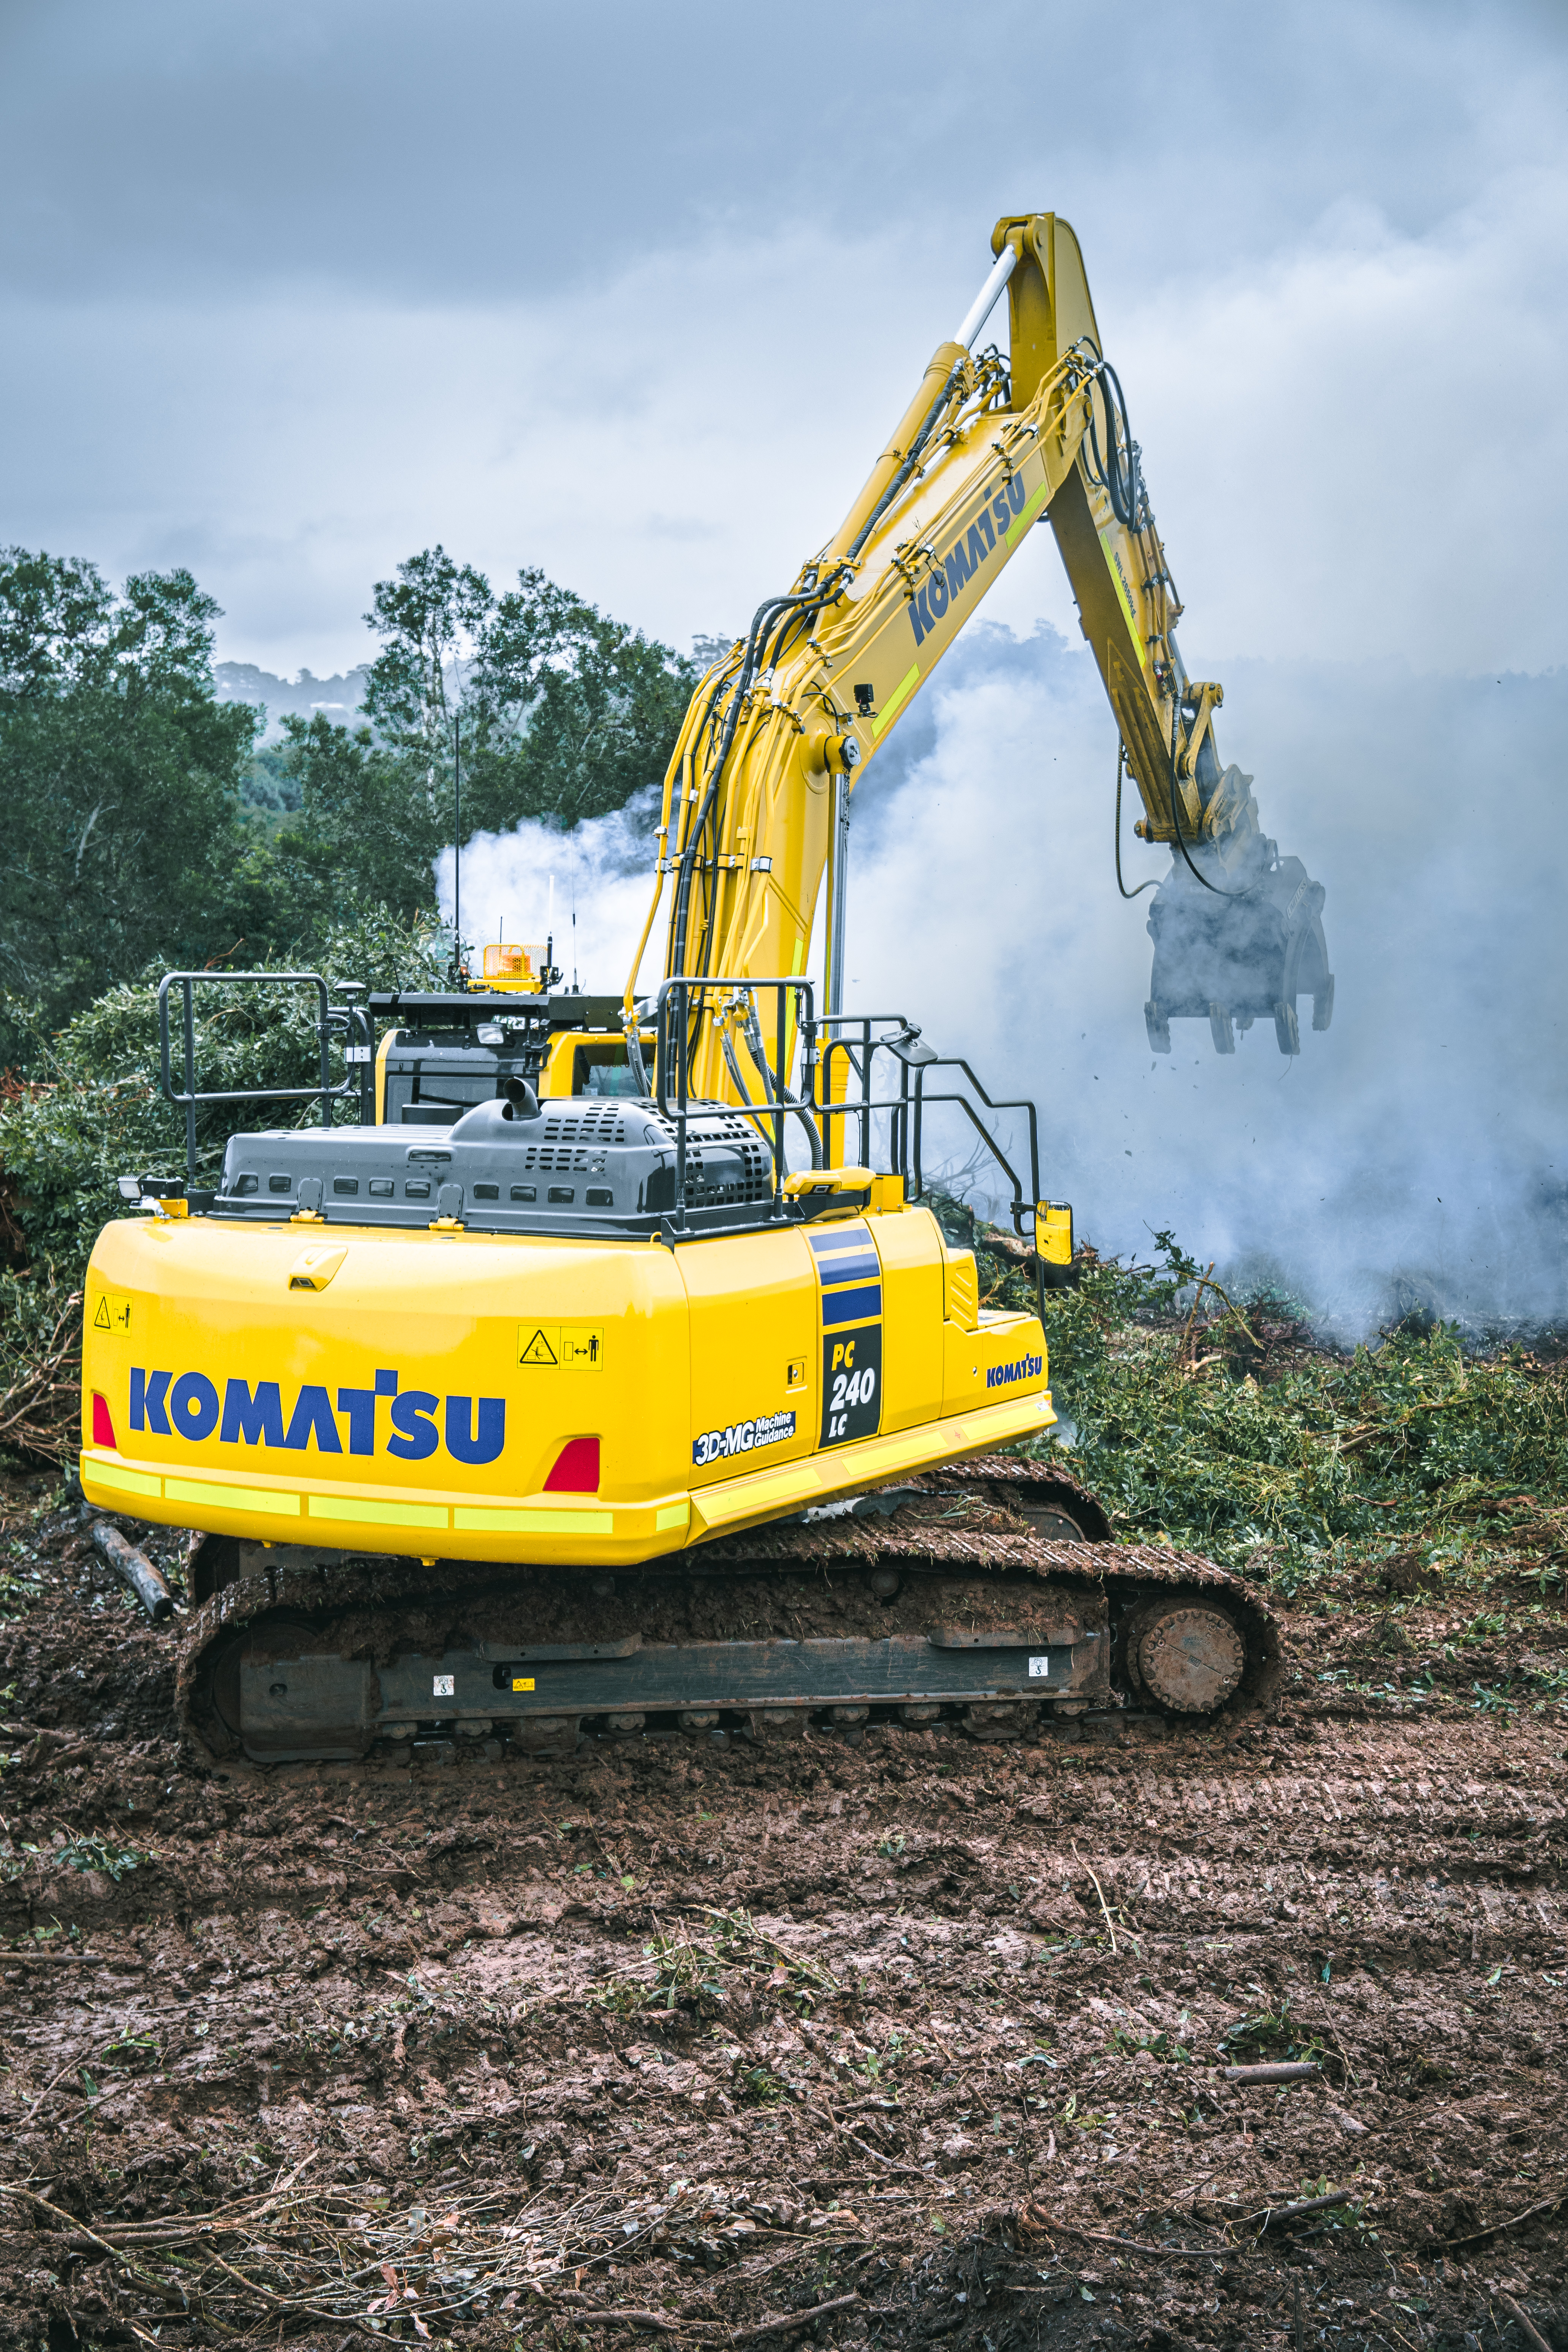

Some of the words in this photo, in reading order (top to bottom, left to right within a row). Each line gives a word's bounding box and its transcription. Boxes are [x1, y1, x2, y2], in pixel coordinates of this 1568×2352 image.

[908, 471, 1026, 647] KOMATSU
[1114, 552, 1123, 578] SWL
[831, 1340, 855, 1371] PC
[987, 1353, 1042, 1388] KOMATSU
[829, 1367, 875, 1412] 240
[130, 1367, 506, 1464] KOMATSU
[756, 1411, 792, 1433] Machine
[828, 1413, 848, 1438] LC
[695, 1421, 755, 1465] 3D-MG
[754, 1425, 794, 1448] Guidance
